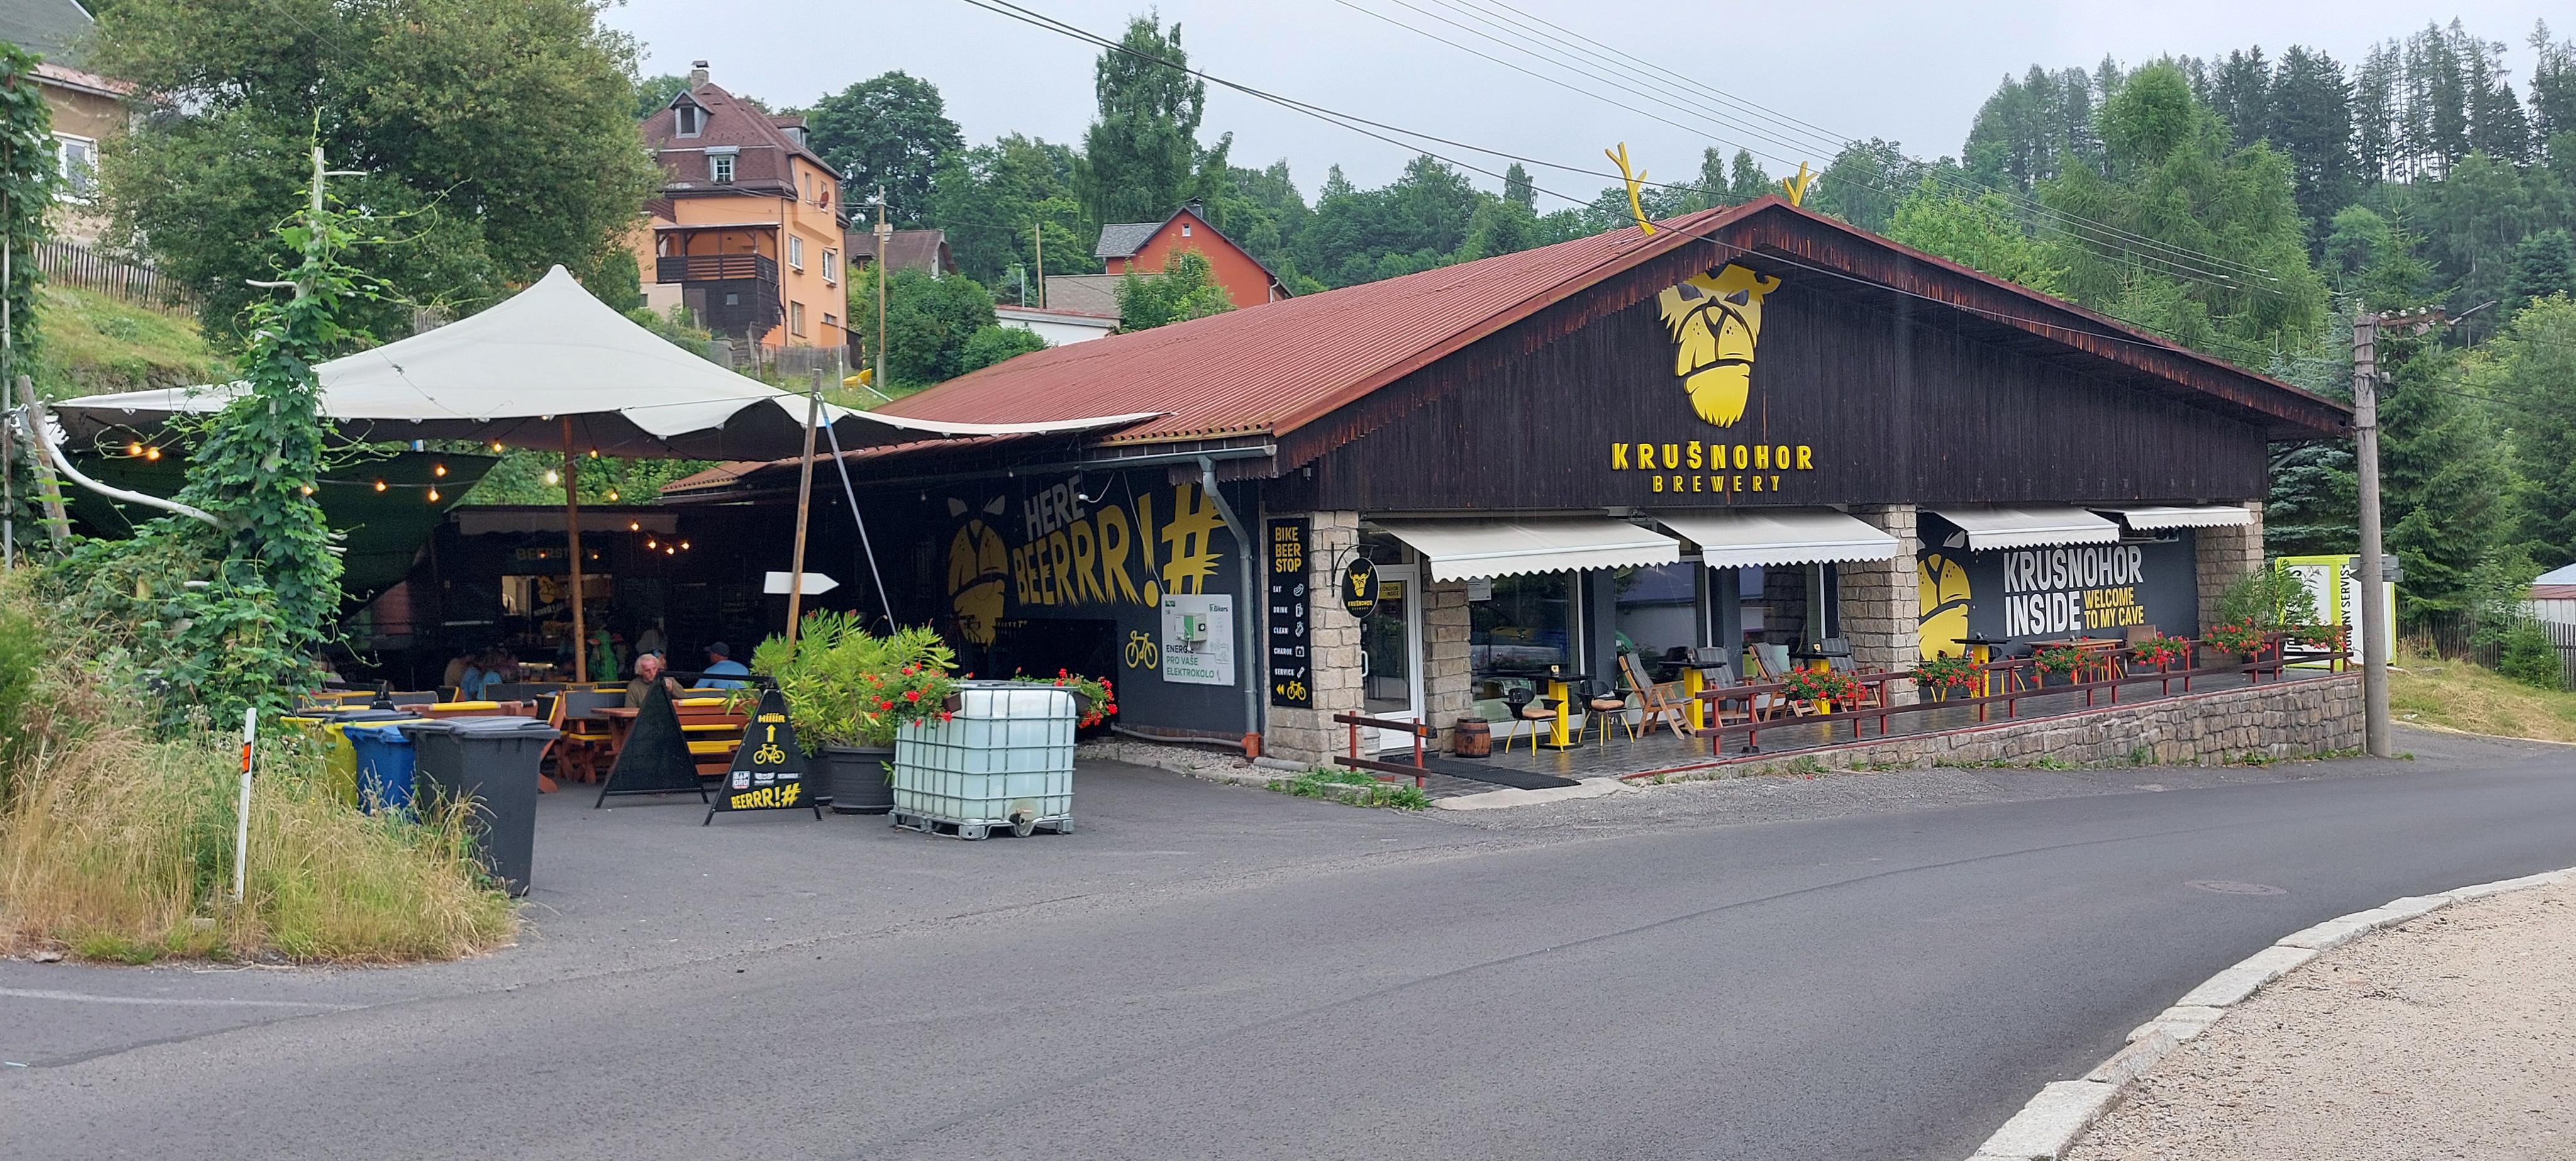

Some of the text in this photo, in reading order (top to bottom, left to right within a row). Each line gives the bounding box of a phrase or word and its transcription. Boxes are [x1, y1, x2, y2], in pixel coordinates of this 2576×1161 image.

[1611, 440, 1814, 470] KRUŠNOHOR
[1652, 475, 1780, 492] BREWERY
[1024, 475, 1085, 542] HERE
[1275, 527, 1299, 542] BIKE
[1275, 543, 1301, 558] BEER
[1275, 558, 1302, 573] STOP
[2340, 569, 2351, 608] SERVIS
[2083, 587, 2135, 609] WELCOME
[2005, 591, 2082, 637] INSIDE
[2084, 605, 2145, 630] TO MY CAVE
[1166, 655, 1198, 666] PRO VAŠE
[1166, 667, 1214, 678] ELEKTROKOLO
[1274, 668, 1294, 676] SERVICE
